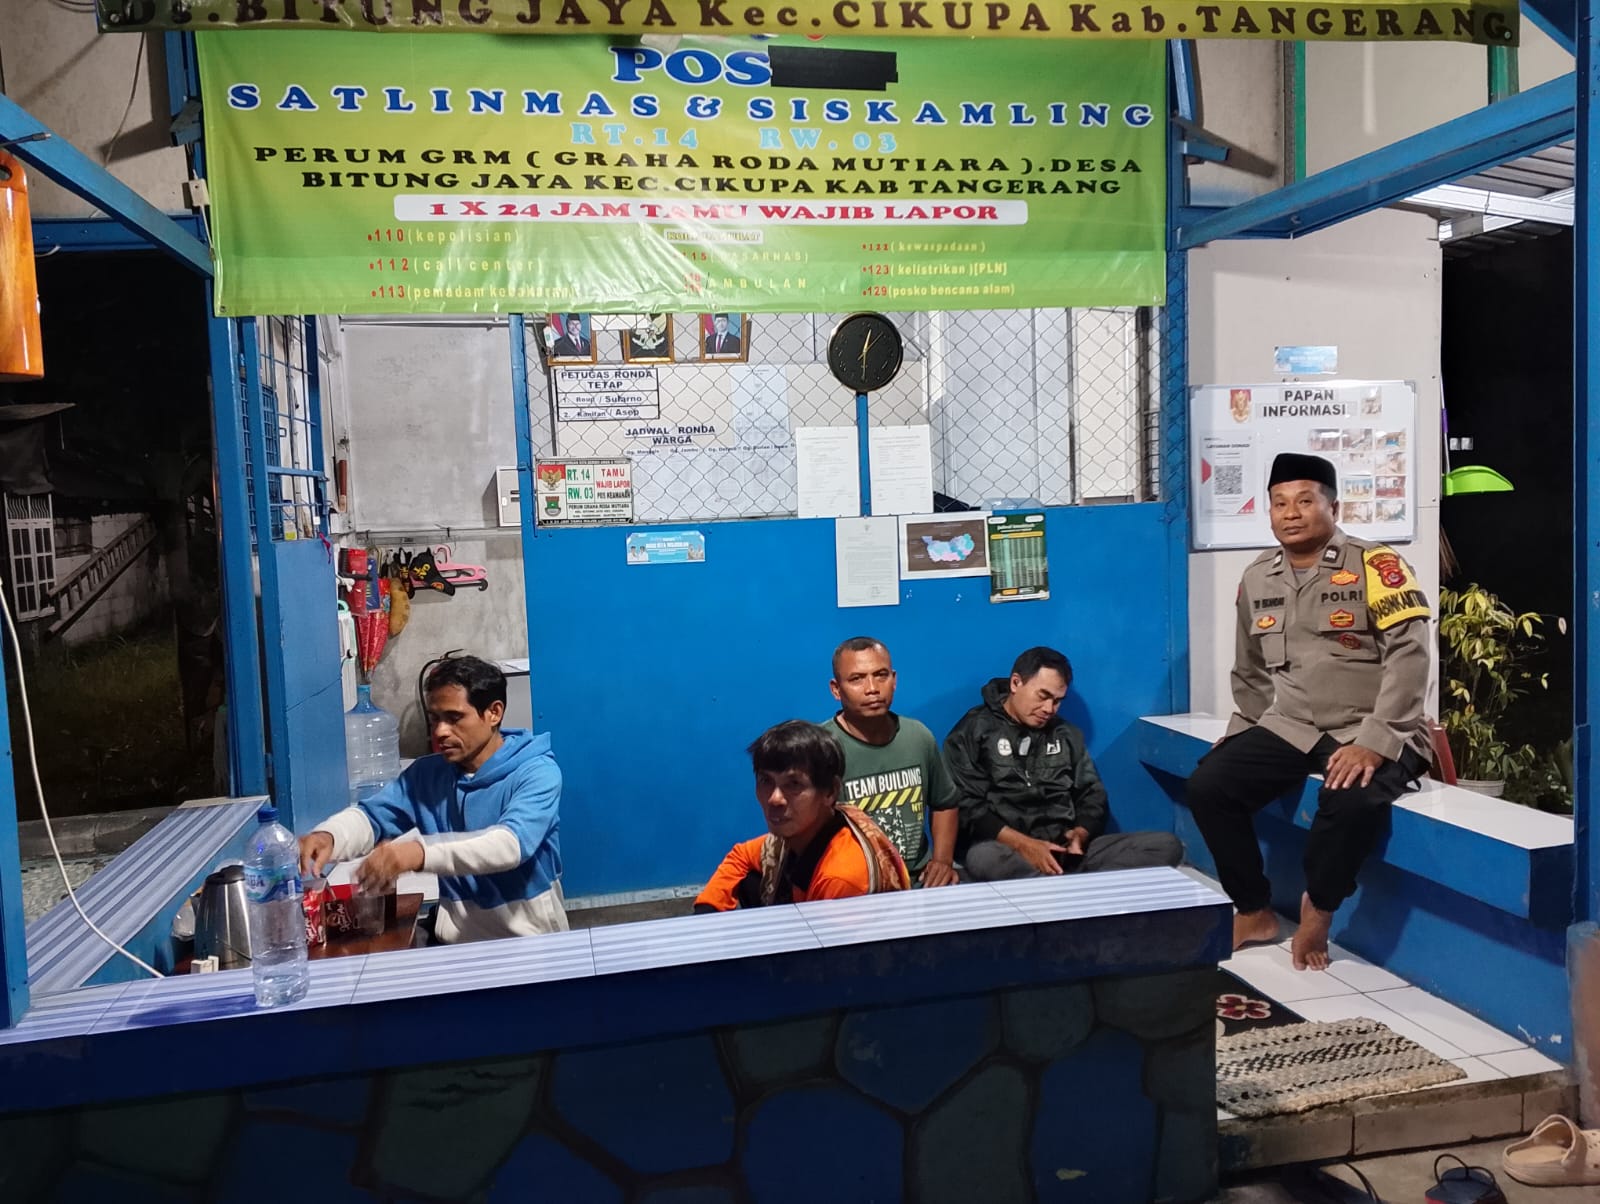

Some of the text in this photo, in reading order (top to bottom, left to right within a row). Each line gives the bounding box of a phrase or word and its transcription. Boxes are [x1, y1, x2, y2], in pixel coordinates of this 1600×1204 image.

[516, 0, 677, 26] JAYA
[612, 47, 771, 86] POS
[228, 84, 1155, 127] SATLINMAS & SISKAMLING
[255, 147, 406, 164] PERUM
[421, 149, 510, 166] GRM
[554, 152, 700, 169] GRAHA
[713, 155, 819, 171] RODA
[832, 157, 1010, 173] MUTIARA
[302, 171, 460, 189] BITUNG
[471, 173, 574, 191] JAYA
[826, 179, 899, 194] KAB
[909, 179, 1122, 195] TANGERANG
[429, 201, 998, 220] 1 X 24 JAM TAMU WAJIB LAPOR
[930, 283, 980, 296] bencana
[561, 370, 654, 380] PETUGAS RONDA
[587, 381, 623, 389] TETAP
[1284, 389, 1334, 401] PAPAN
[1263, 403, 1346, 417] INFORMASI
[625, 425, 715, 436] JADWAL RONDA
[652, 436, 693, 445] WARGA
[581, 469, 590, 481] 14
[601, 468, 625, 477] TAMU
[596, 480, 630, 488] WAJIB LAPOR
[584, 487, 593, 499] 03
[1321, 590, 1363, 603] POLRI
[845, 767, 922, 800] TEAM BUILDING
